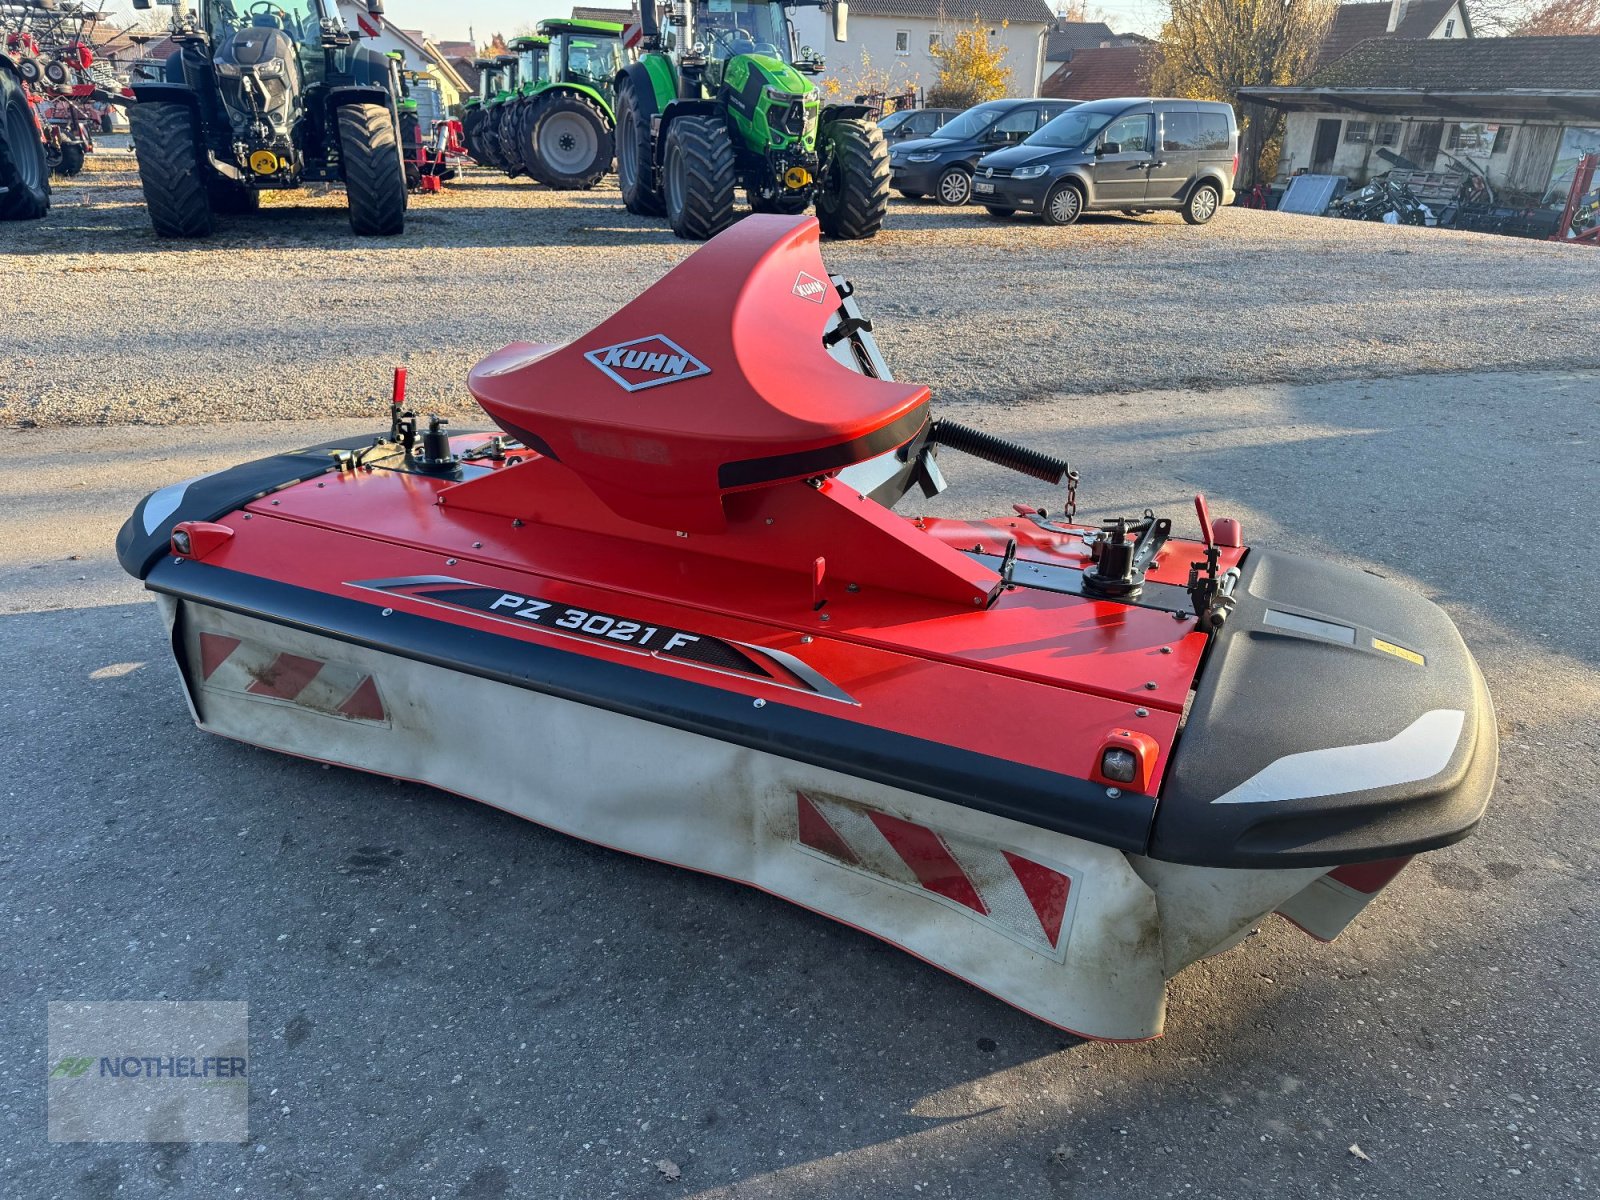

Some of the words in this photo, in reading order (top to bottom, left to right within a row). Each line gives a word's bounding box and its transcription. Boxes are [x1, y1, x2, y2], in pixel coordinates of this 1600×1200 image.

[796, 281, 824, 297] KUHN
[602, 347, 690, 375] KUHN
[489, 593, 552, 620] PZ
[555, 609, 658, 645] 3021
[662, 632, 700, 650] F
